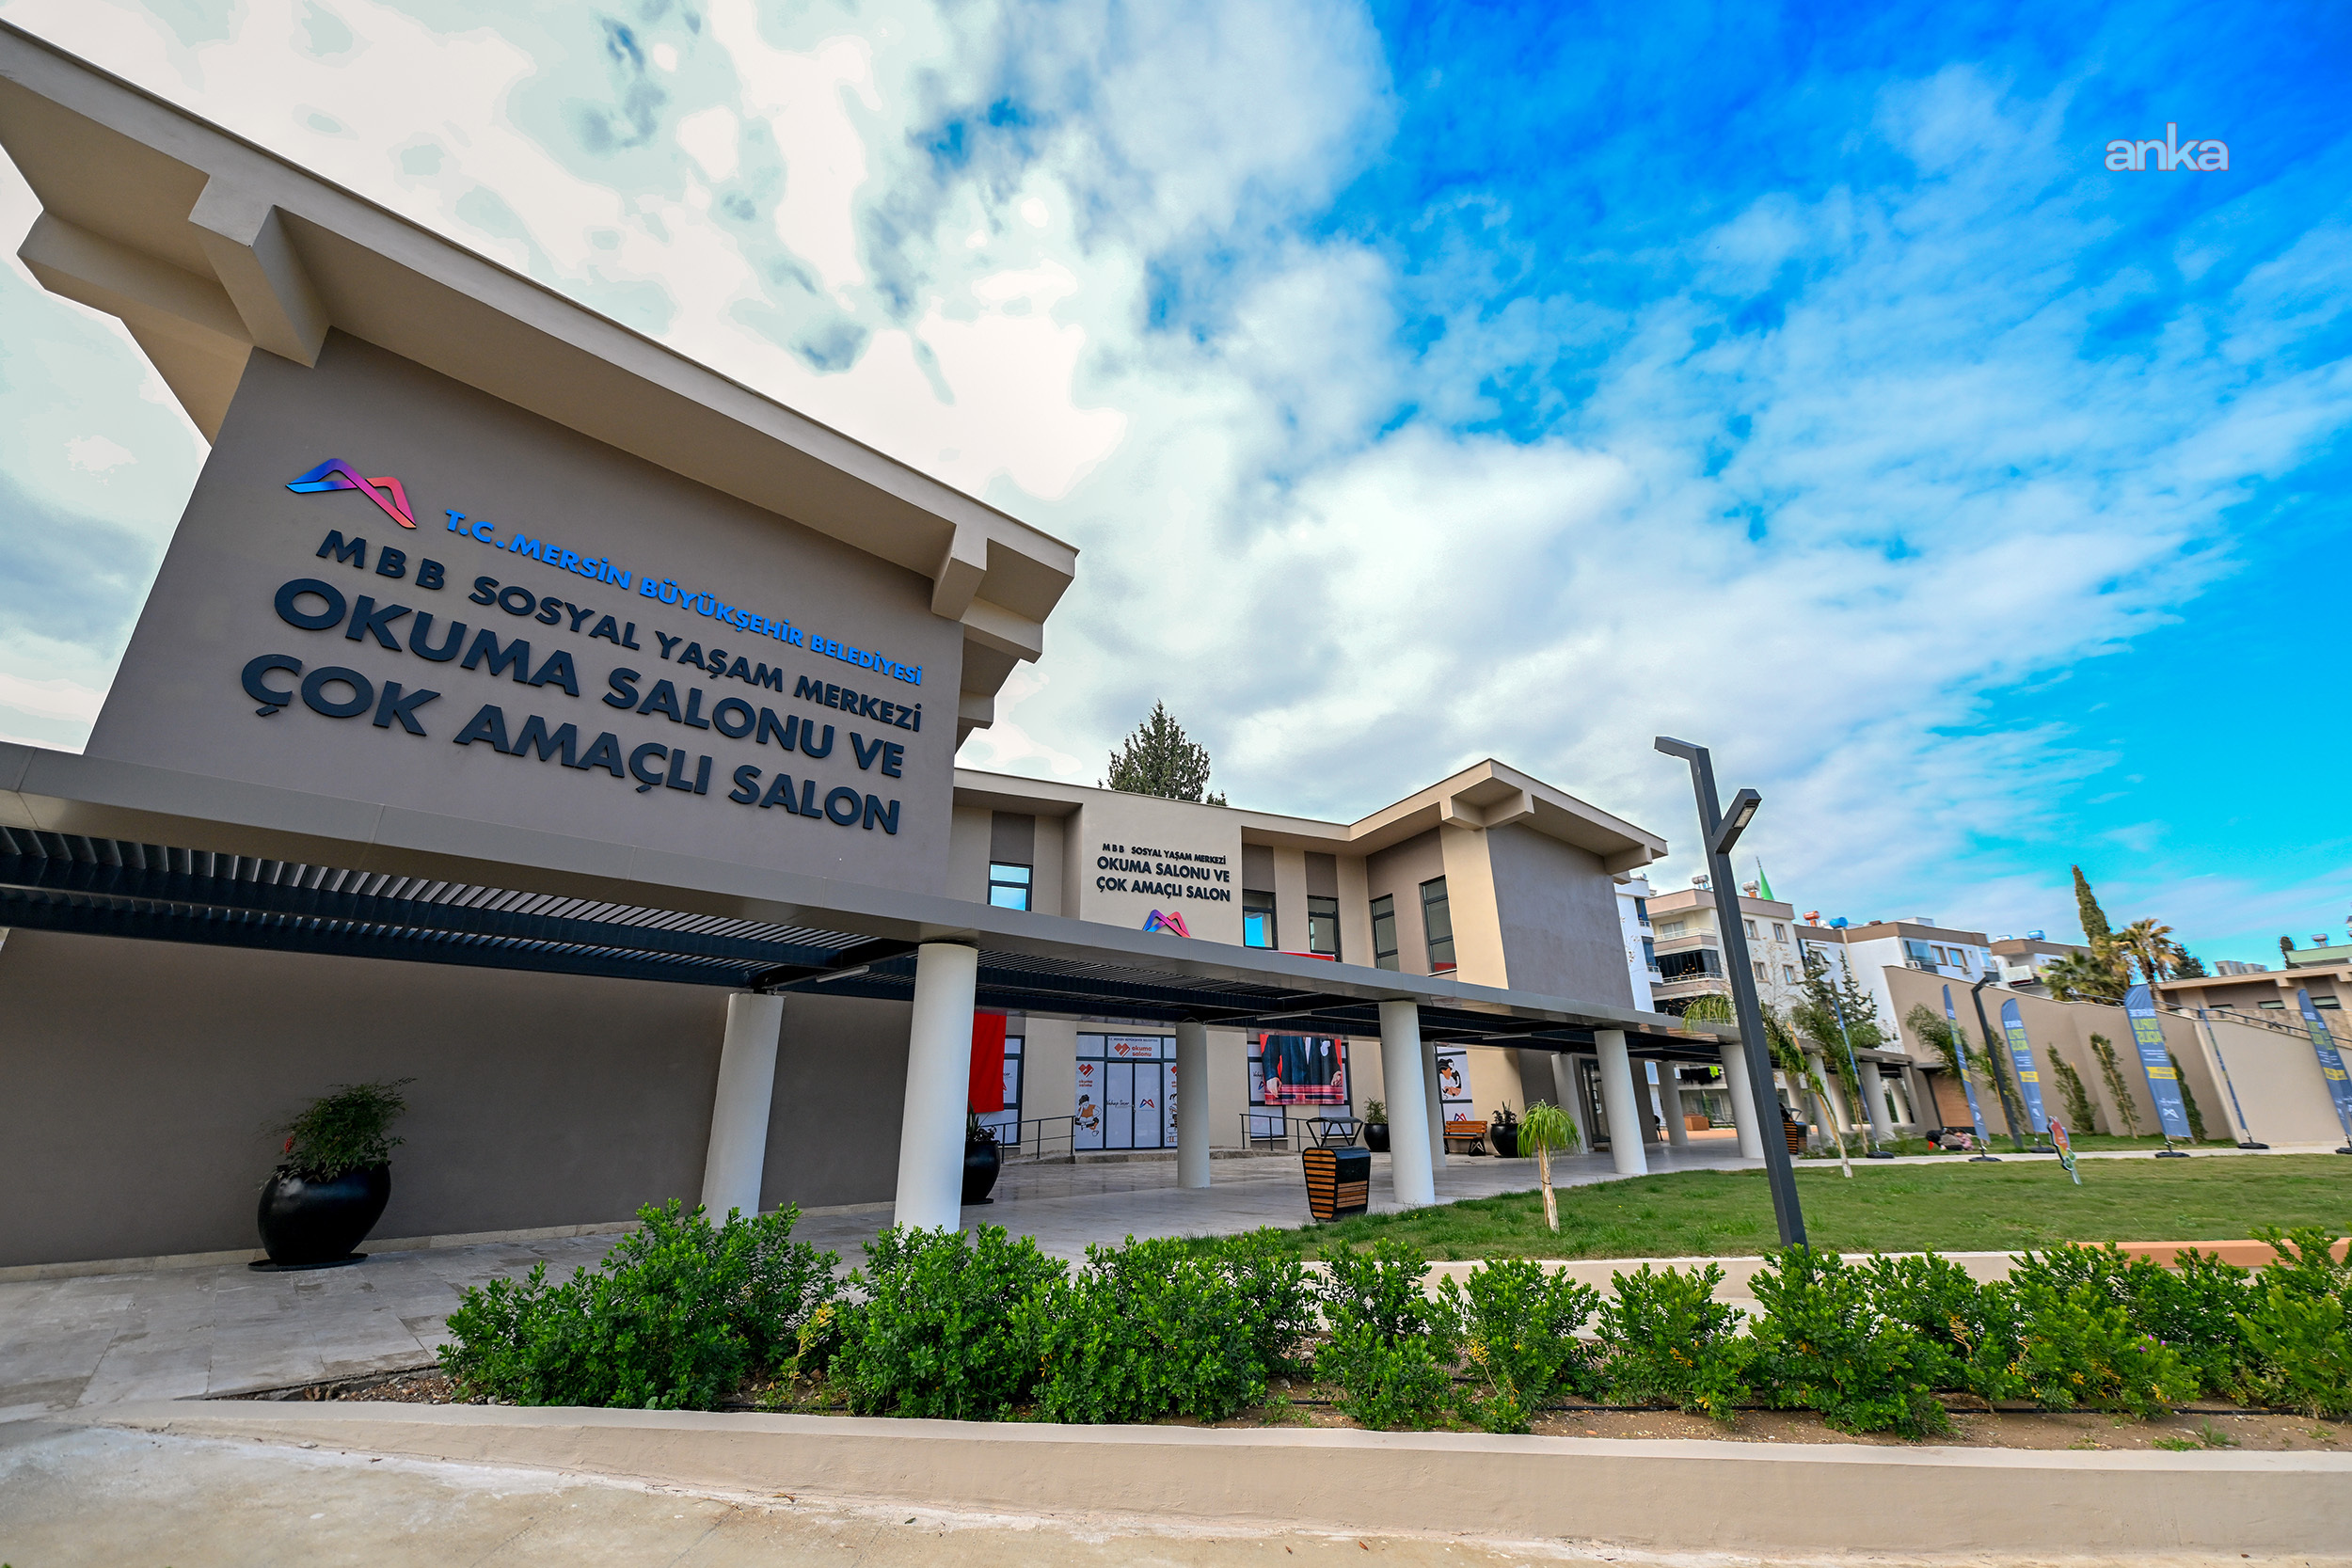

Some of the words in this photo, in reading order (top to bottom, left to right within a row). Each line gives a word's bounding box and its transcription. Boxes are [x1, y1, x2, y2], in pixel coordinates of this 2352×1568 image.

[273, 578, 581, 699] OKUMA
[602, 667, 835, 760] SALONU
[849, 731, 905, 780] VE
[468, 576, 642, 652] SOSYAL
[654, 630, 785, 693] YAŞAM
[793, 675, 922, 733] MERKEZİ
[639, 578, 804, 648] BÜYÜKŞEHİR
[810, 635, 923, 686] BELEDİYESİ
[240, 653, 442, 738] ÇOK
[452, 704, 713, 797] AMAÇLI
[727, 764, 901, 836] SALON
[1095, 876, 1128, 894] ÇOK
[1130, 879, 1183, 899] AMAÇLI
[1185, 885, 1232, 903] SALON
[1096, 855, 1152, 875] OKUMA
[1155, 862, 1211, 881] SALONU
[1213, 868, 1231, 883] VE
[1131, 846, 1163, 858] SOSYAL
[1163, 849, 1193, 862] YAŞAM
[1193, 853, 1227, 865] MERKEZİ
